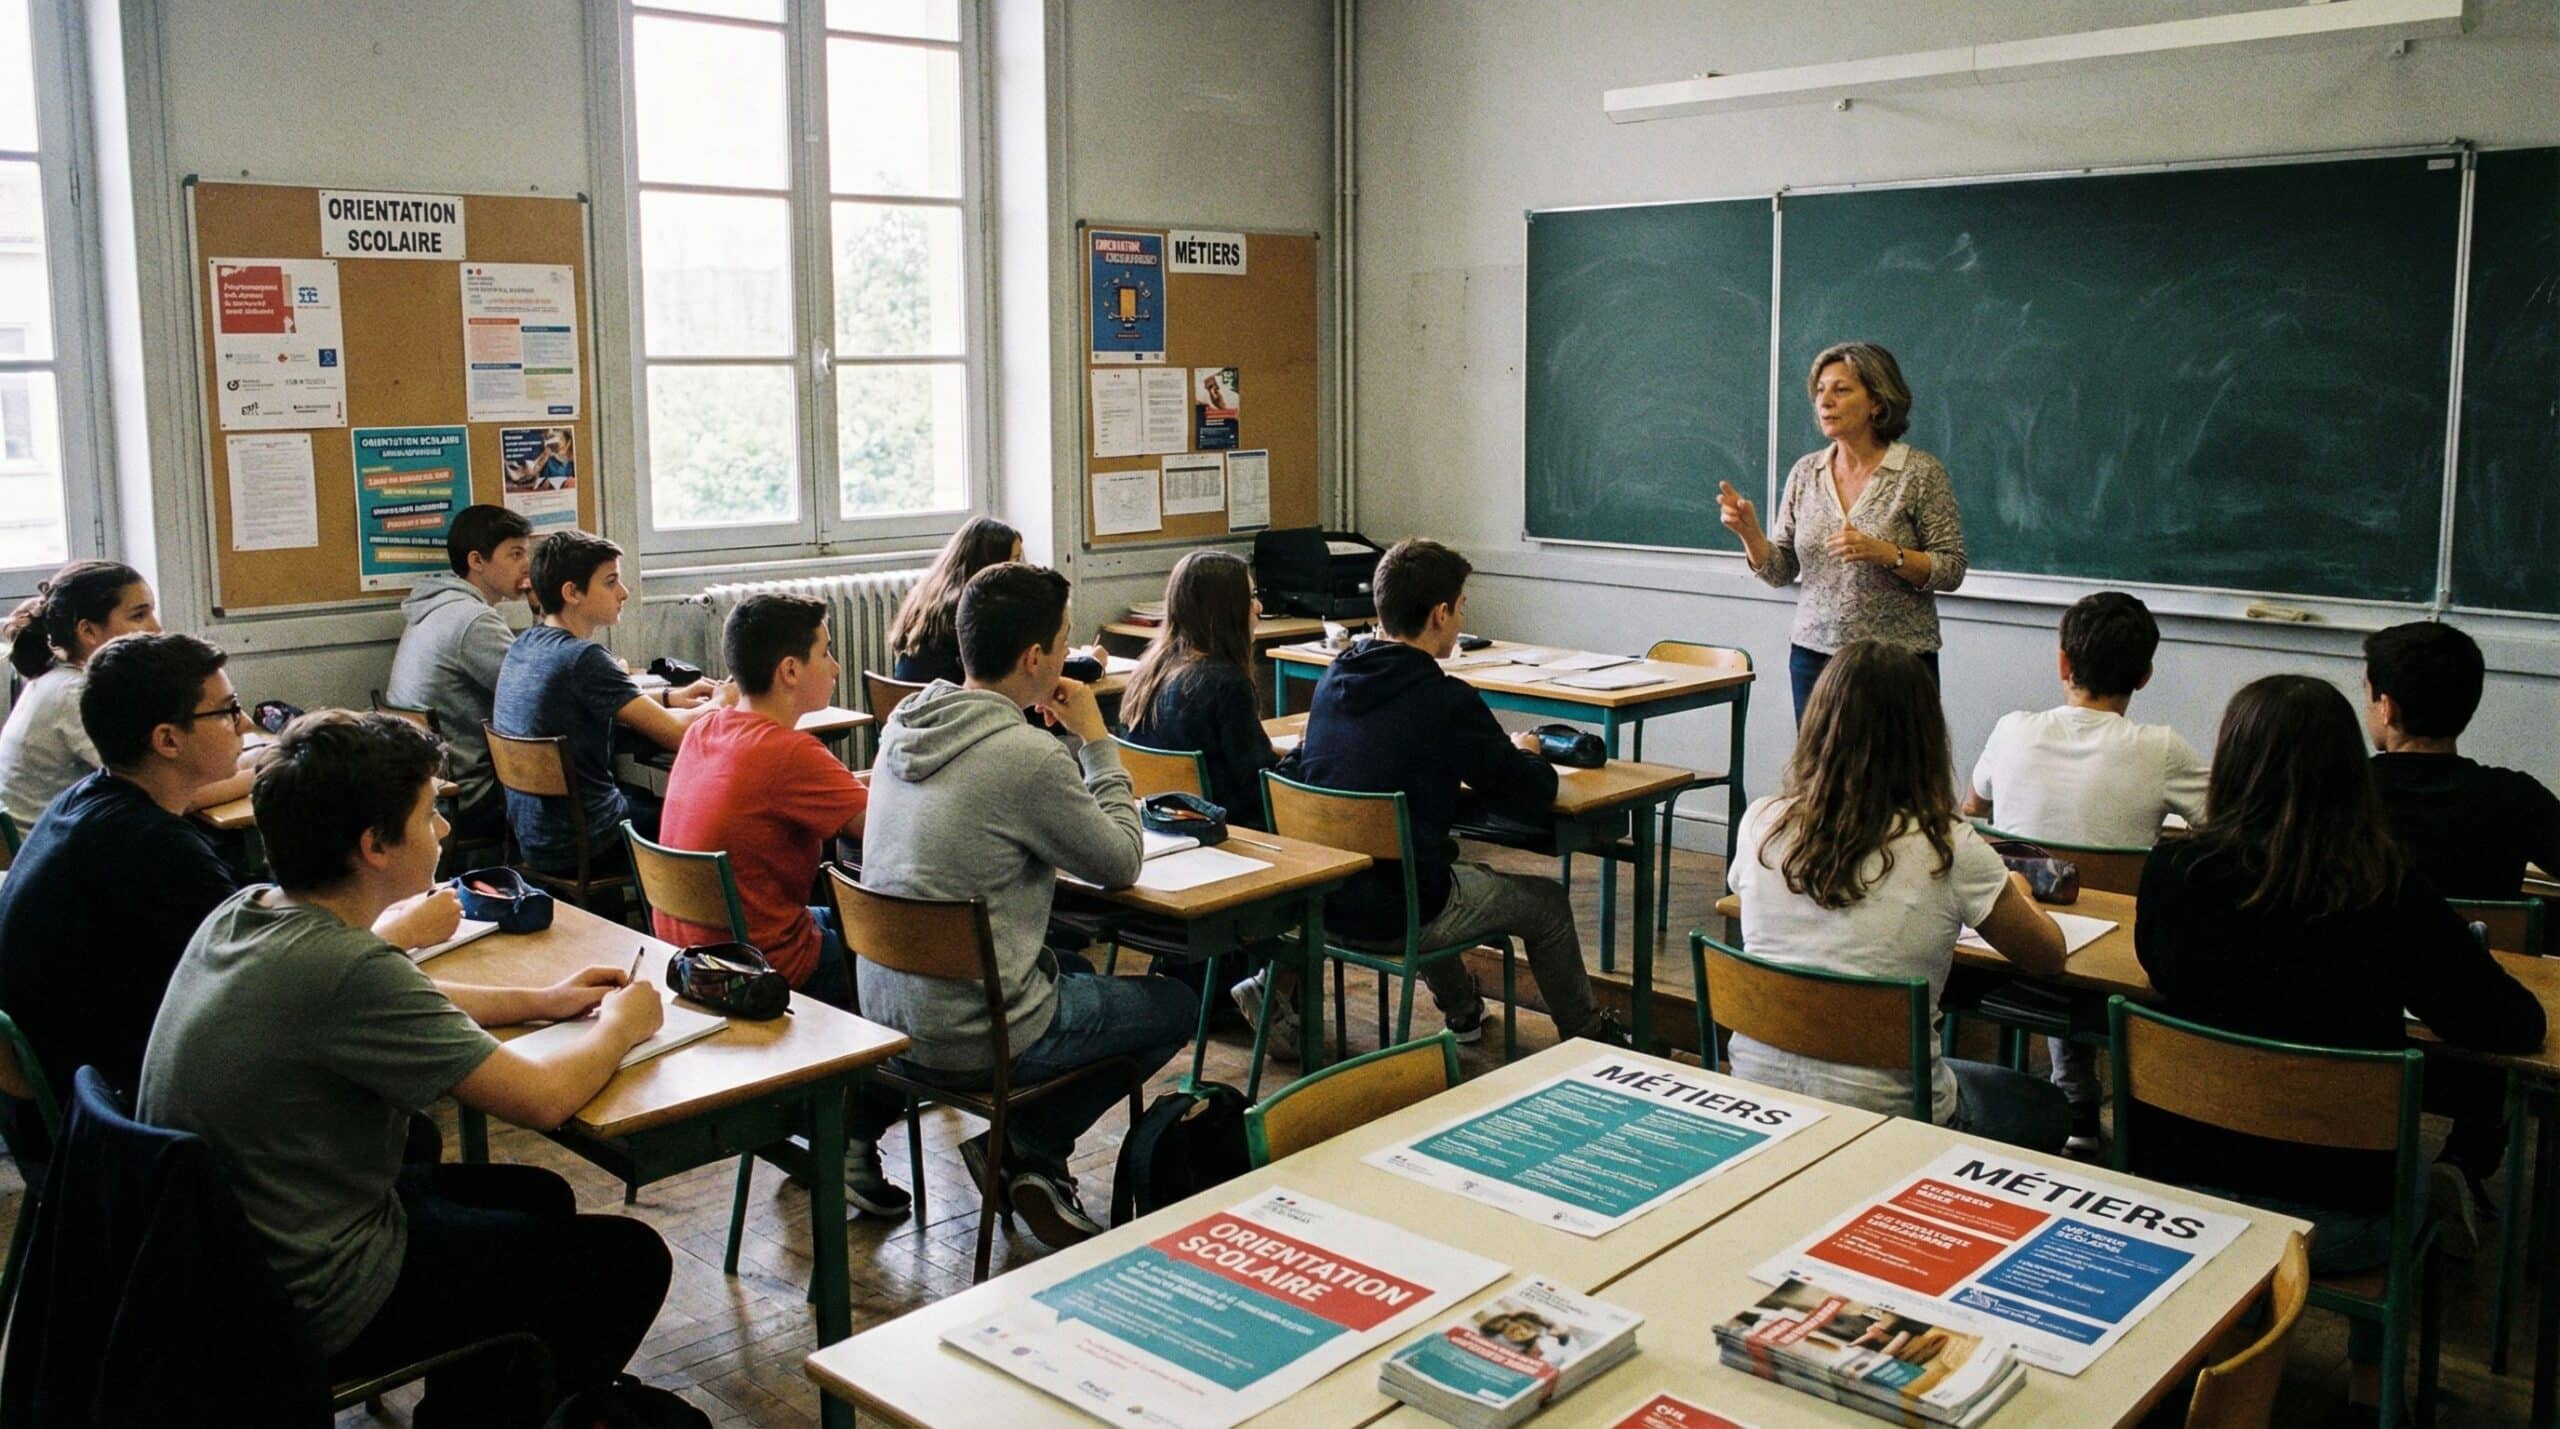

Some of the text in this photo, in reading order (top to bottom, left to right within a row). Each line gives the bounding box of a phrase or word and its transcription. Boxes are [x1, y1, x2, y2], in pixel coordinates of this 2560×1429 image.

[329, 198, 456, 224] ORIENTATION
[348, 229, 442, 253] SCOLAIRE
[1175, 235, 1240, 266] MÉTIERS
[1593, 1064, 1792, 1126] MÉTIERS
[1953, 1159, 2206, 1241] MÉTIERS
[1177, 1235, 1334, 1303] SCOLAIRE
[1208, 1222, 1412, 1307] ORIENTATION
